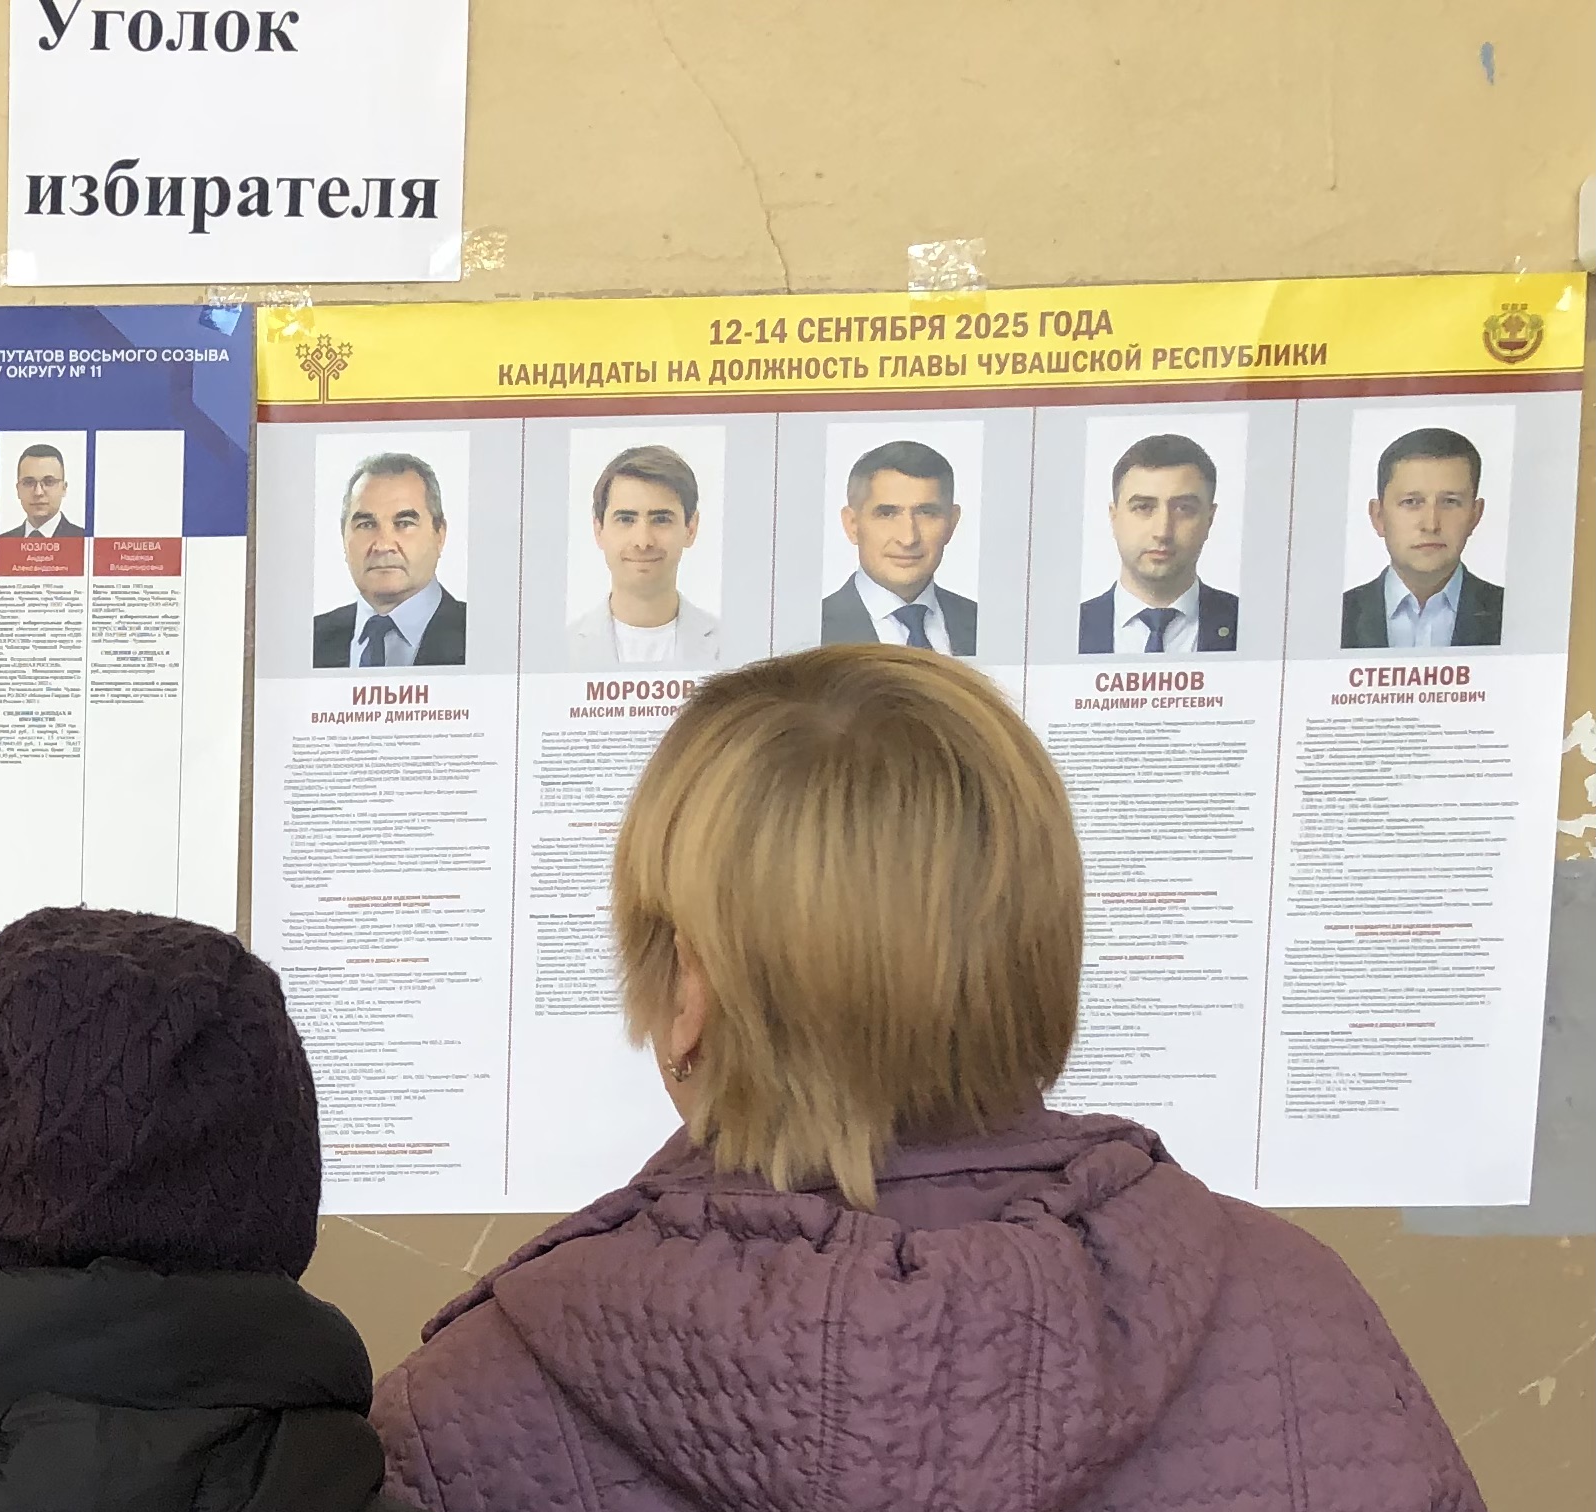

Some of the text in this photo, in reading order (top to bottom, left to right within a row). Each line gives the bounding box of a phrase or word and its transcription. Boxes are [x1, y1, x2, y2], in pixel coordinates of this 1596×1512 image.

[39, 0, 299, 52] Уголок
[25, 158, 440, 234] избирателя
[710, 310, 1113, 345] 12-14 СЕНТЯБРЯ 2025 ГОДА
[69, 350, 157, 362] ВОСЬМОГО
[162, 349, 229, 361] СОЗЫВА
[7, 365, 66, 378] ОКРУГУ
[70, 365, 85, 377] №
[91, 365, 101, 377] 11
[499, 343, 1327, 389] КАНДИДАТЫ НА ДОЛЖНОСТЬ ГЛАВЫ ЧУВАШСКОЙ РЕСПУБЛИКИ
[21, 543, 59, 551] КОЗЛОВ
[114, 542, 161, 550] ПАРШЕВА
[1096, 672, 1204, 692] САВИНОВ
[1349, 666, 1470, 687] СТЕПАНОВ
[353, 685, 428, 705] ИЛЬИН
[1332, 691, 1485, 705] КОНСТАНТИН ОЛЕГОВИЧ
[570, 705, 680, 718] МАКСИМ ВИКТОР
[1075, 697, 1223, 711] ВЛАДИМИР СЕРГЕЕВИЧ
[312, 709, 469, 724] ВЛАДИМИР ДМИТРИЕВИЧ
